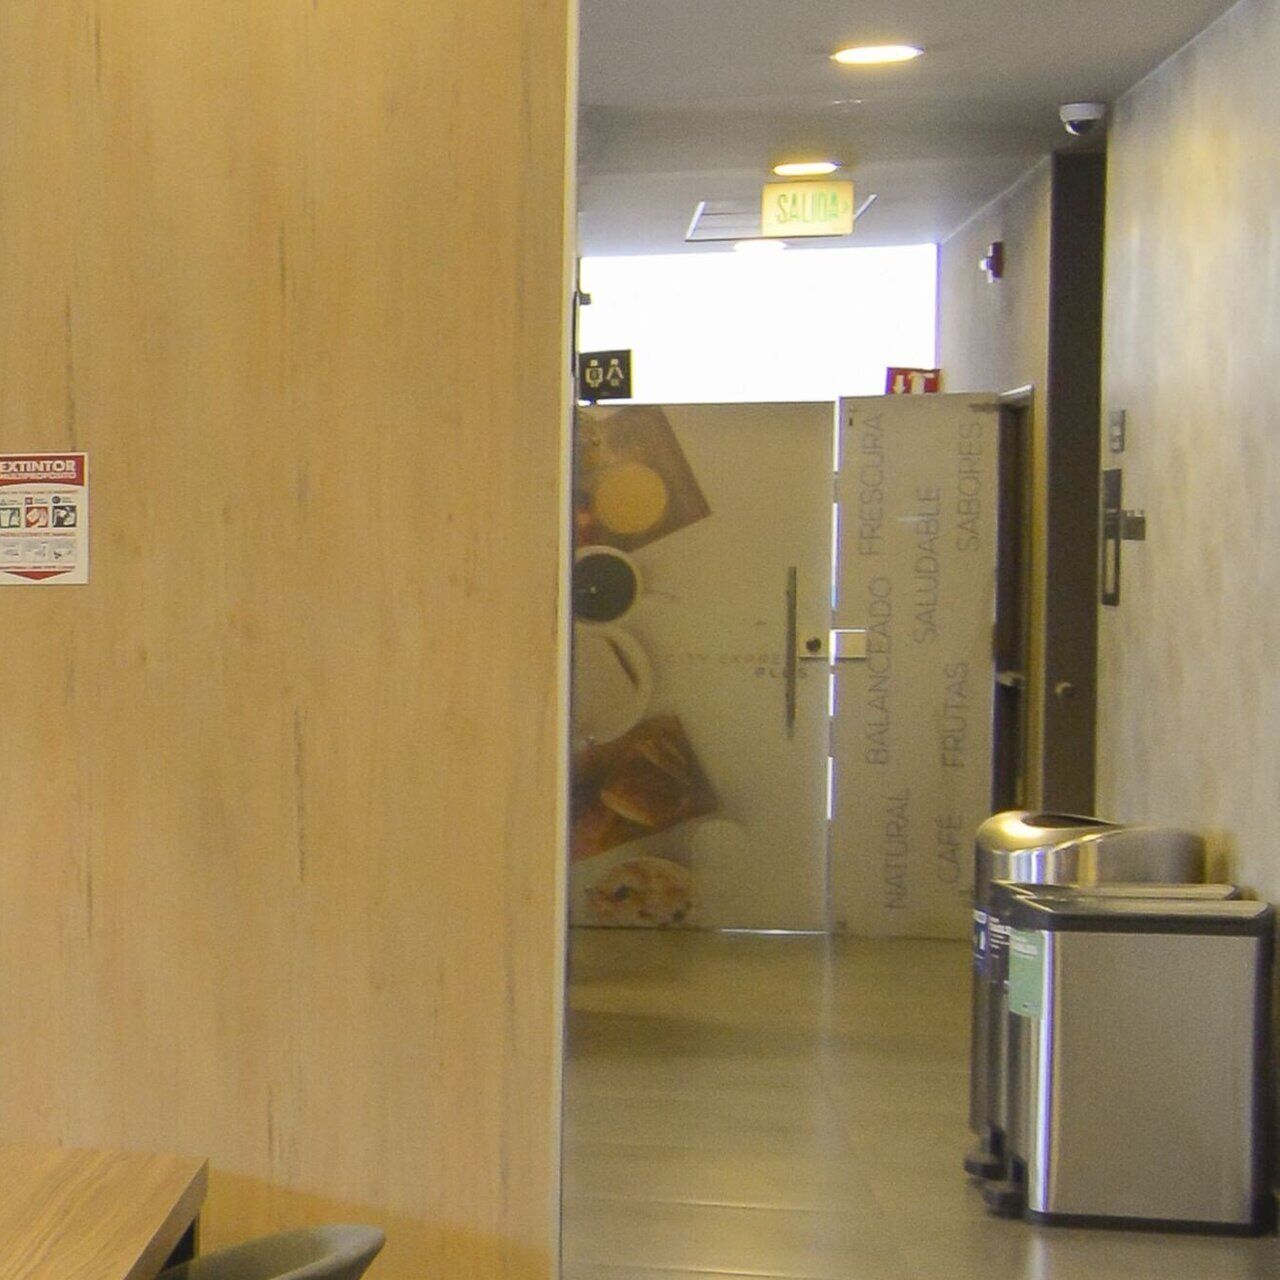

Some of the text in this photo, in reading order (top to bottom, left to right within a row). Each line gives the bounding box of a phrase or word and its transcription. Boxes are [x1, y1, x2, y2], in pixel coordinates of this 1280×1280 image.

[777, 192, 838, 223] SALIDA
[858, 413, 885, 556] FRESCURA
[956, 423, 983, 552] SABORES
[913, 487, 940, 645] SALUDABLE
[865, 577, 892, 766] BALANCEADO
[941, 661, 968, 768] FRUTAS
[883, 788, 910, 909] NATURAL
[934, 814, 962, 884] CAFÉ
